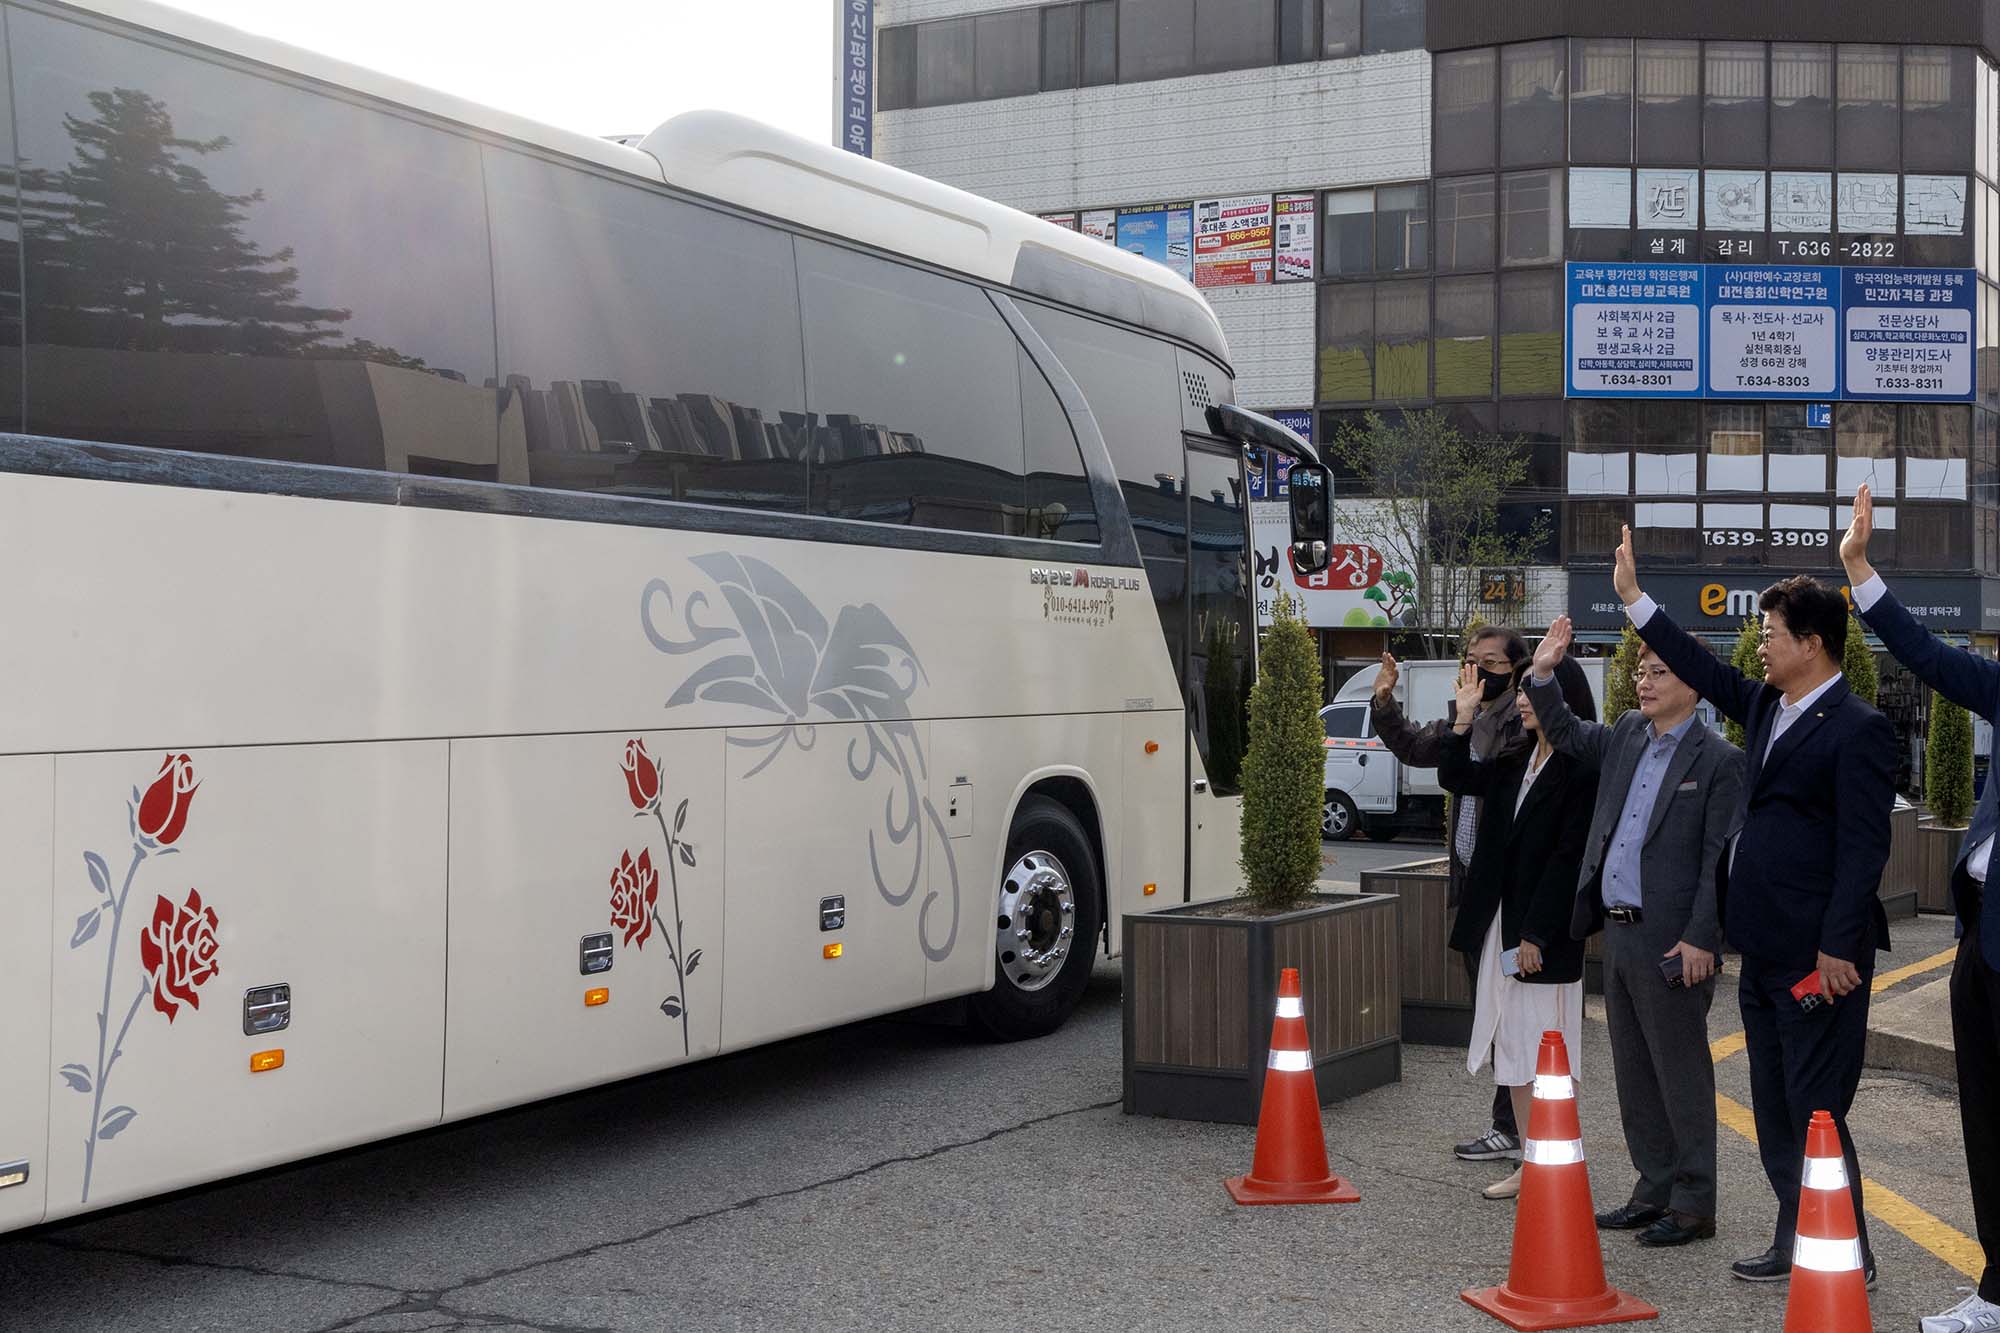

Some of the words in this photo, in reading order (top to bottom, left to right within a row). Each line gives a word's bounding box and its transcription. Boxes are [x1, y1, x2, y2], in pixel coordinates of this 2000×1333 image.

[849, 0, 867, 156] 신평생교육
[1231, 215, 1269, 230] 소액결제
[1575, 269, 1604, 280] 교육부
[1607, 269, 1646, 281] 평가인정
[1649, 270, 1698, 282] 학점은행제
[1725, 271, 1822, 284] (사)대한예수교장로회
[1854, 272, 1942, 286] 한국직업능력개발원
[1944, 274, 1964, 286] 등록
[1582, 283, 1691, 298] 대전총신평생교육원
[1719, 285, 1828, 300] 대전총회신학연구원
[1865, 288, 1925, 302] 민간자격증
[1929, 289, 1953, 302] 과정
[1597, 310, 1654, 323] 사회복지사
[1657, 311, 1675, 324] 2급
[1878, 314, 1940, 329] 전문상담사
[1657, 327, 1675, 340] 2급
[1752, 331, 1766, 341] 1년
[1769, 331, 1795, 342] 4학기
[1597, 342, 1654, 356] 평생교육사
[1657, 343, 1675, 356] 2급
[1745, 344, 1802, 355] 실천목회중심
[1865, 348, 1952, 362] 양봉관리지도사
[1740, 357, 1758, 368] 성경
[1761, 357, 1785, 368] 66권
[1788, 358, 1807, 369] 강해
[1875, 364, 1908, 373] 기초부터
[1910, 364, 1943, 374] 창업까지
[1600, 374, 1672, 385] T.634-8301
[1736, 375, 1810, 387] T.634-8303
[1875, 378, 1943, 389] T.633-8311
[1252, 476, 1263, 490] 2F
[1591, 602, 1616, 613] 새로운
